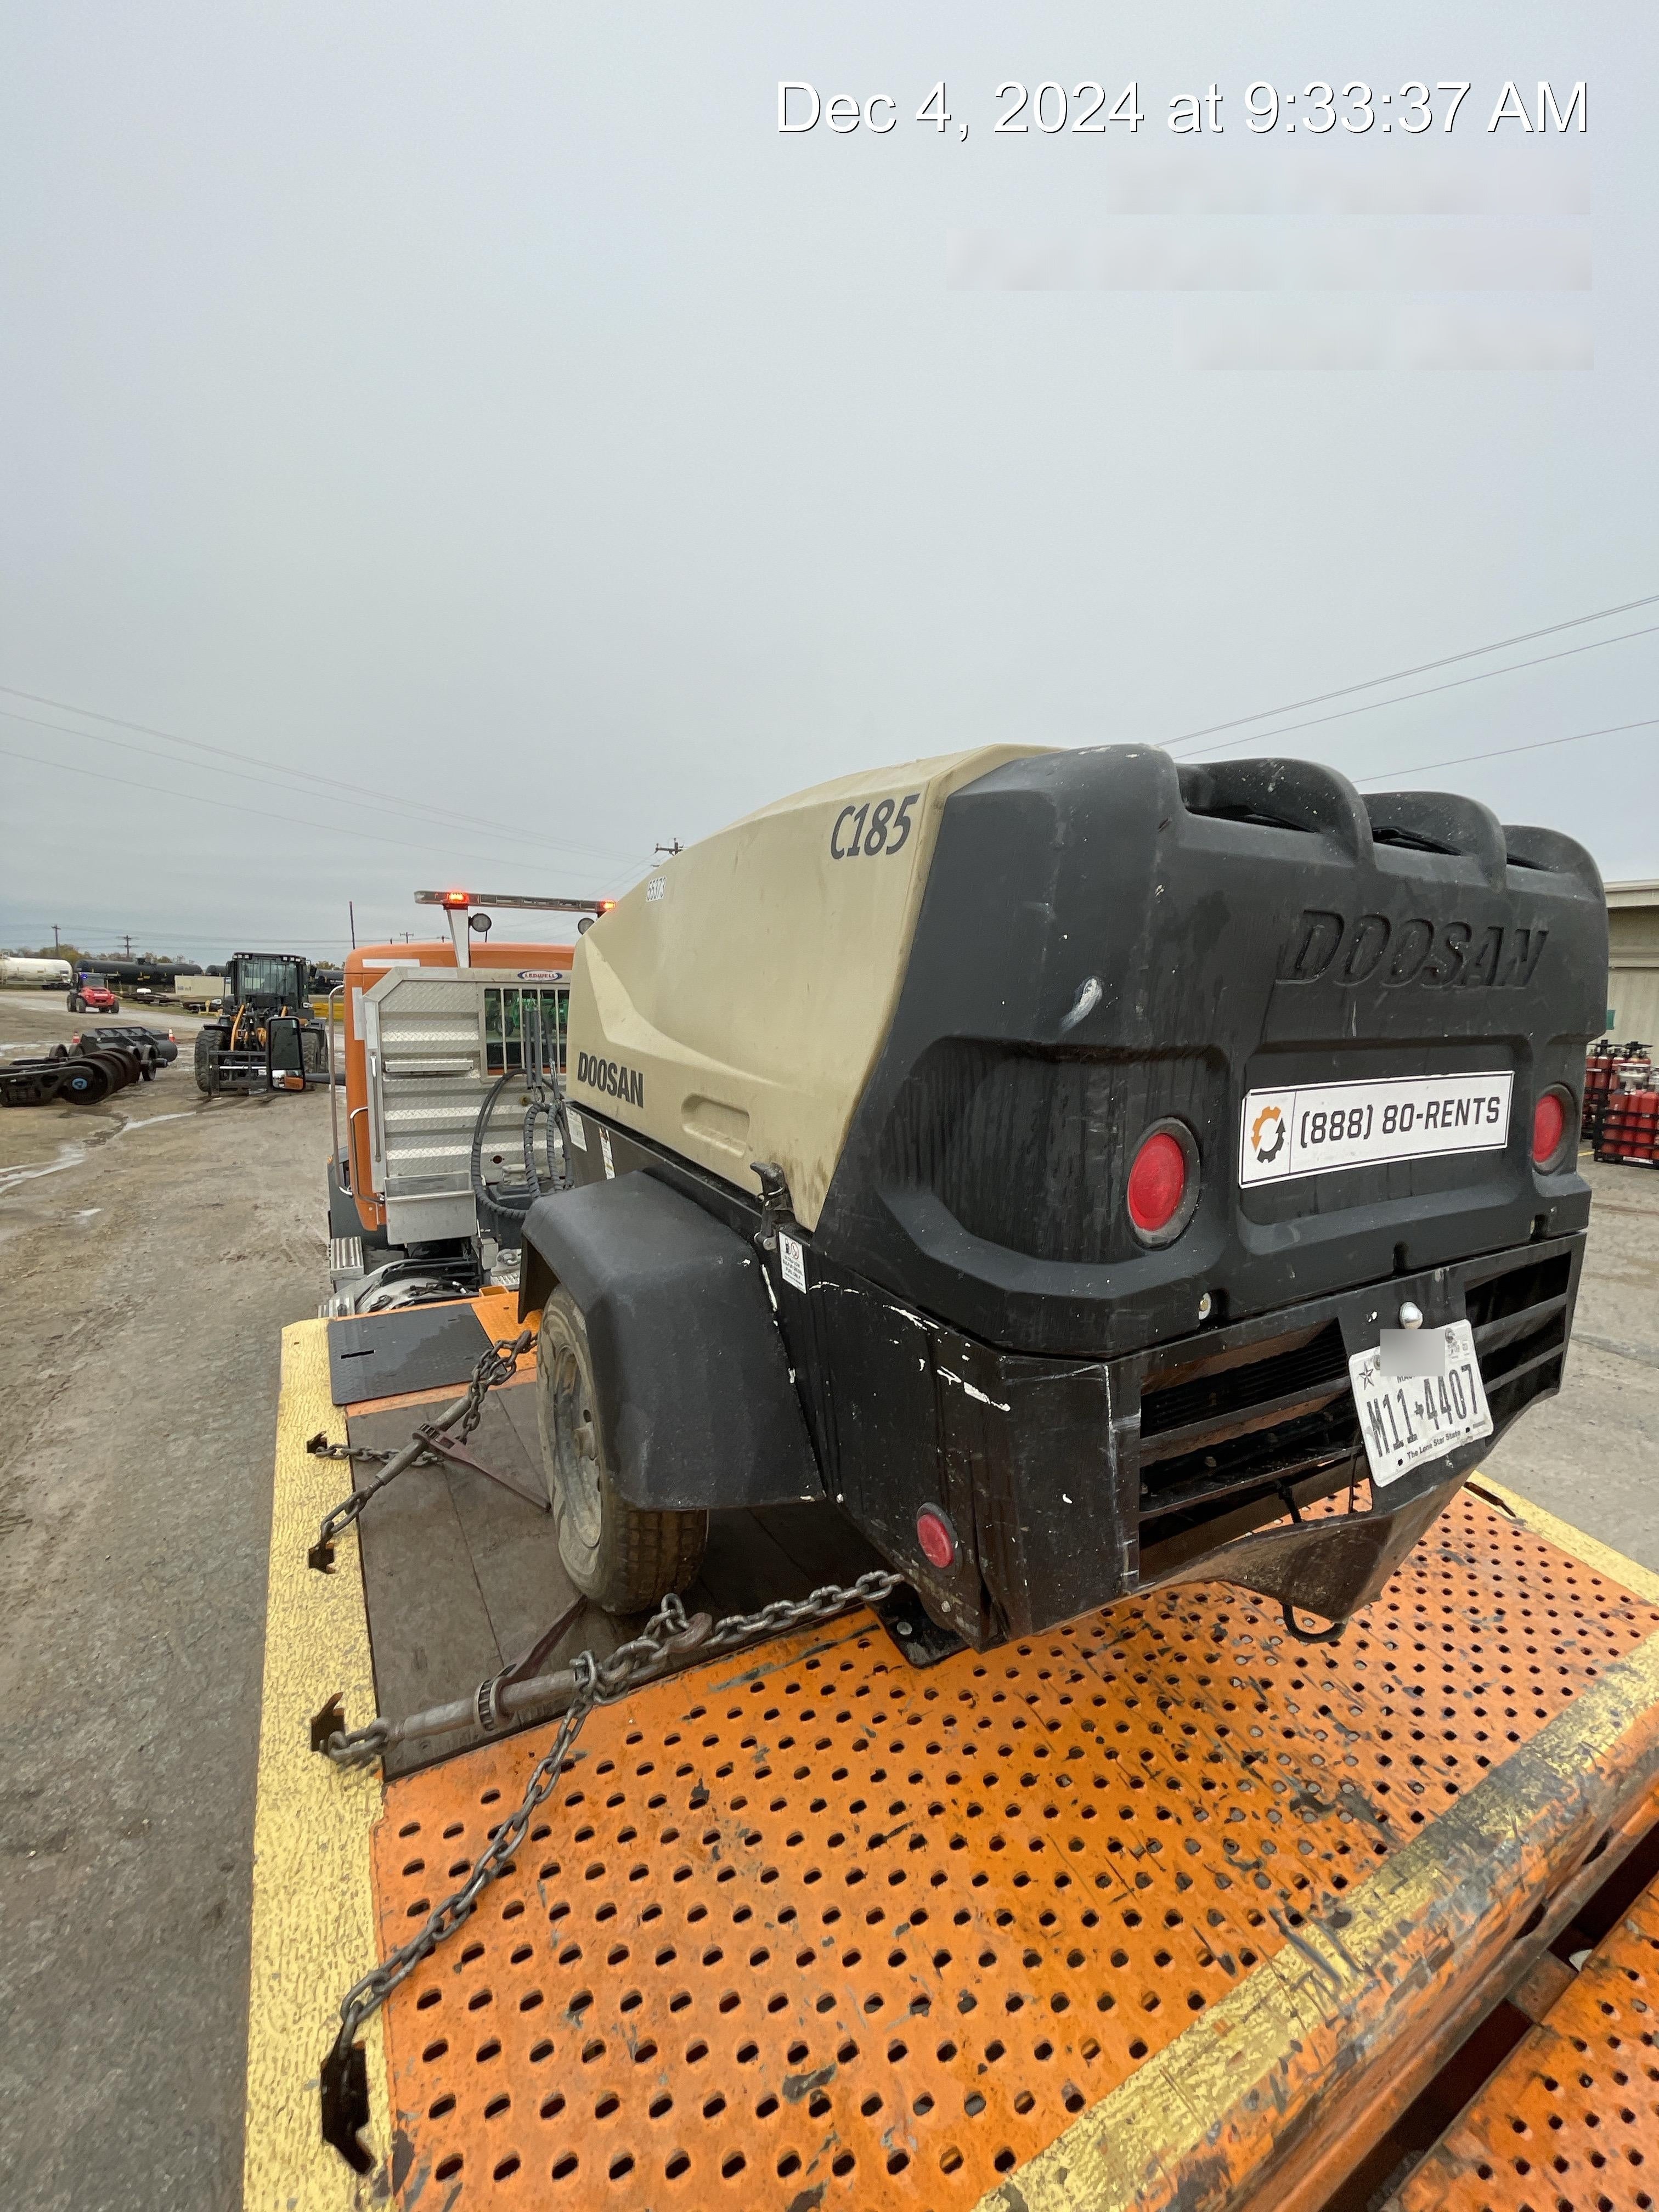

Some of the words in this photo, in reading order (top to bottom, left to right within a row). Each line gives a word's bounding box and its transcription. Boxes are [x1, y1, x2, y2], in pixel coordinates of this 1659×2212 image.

[831, 793, 921, 860] C185
[647, 877, 666, 901] 55373
[1275, 909, 1549, 989] DOOSAN
[577, 1051, 644, 1109] DOOSAN
[1300, 1104, 1373, 1149] (888)
[1382, 1096, 1500, 1134] 80-RENTS
[1407, 1451, 1419, 1460] The
[1419, 1443, 1432, 1454] Lone
[1433, 1436, 1444, 1446] Star
[1445, 1430, 1461, 1441] State
